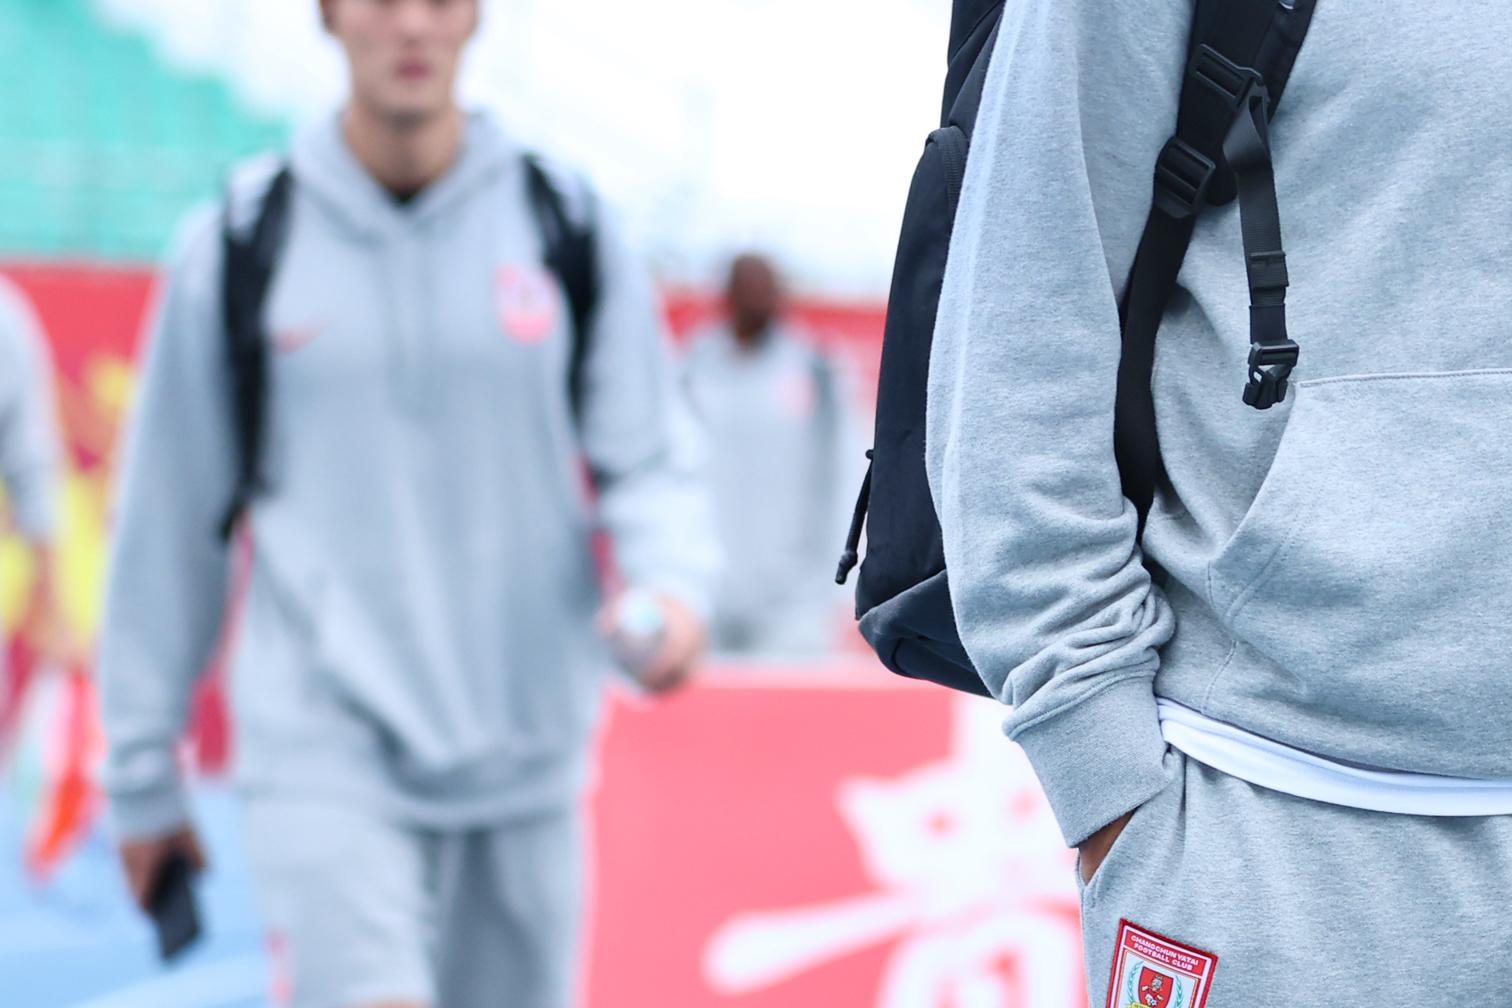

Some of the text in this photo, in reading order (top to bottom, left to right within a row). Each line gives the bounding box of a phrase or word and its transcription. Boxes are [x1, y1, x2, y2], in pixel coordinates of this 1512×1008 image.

[1130, 935, 1199, 966] CHANGCHUN YATAI
[1133, 943, 1193, 971] FOOTBALL CLUB
